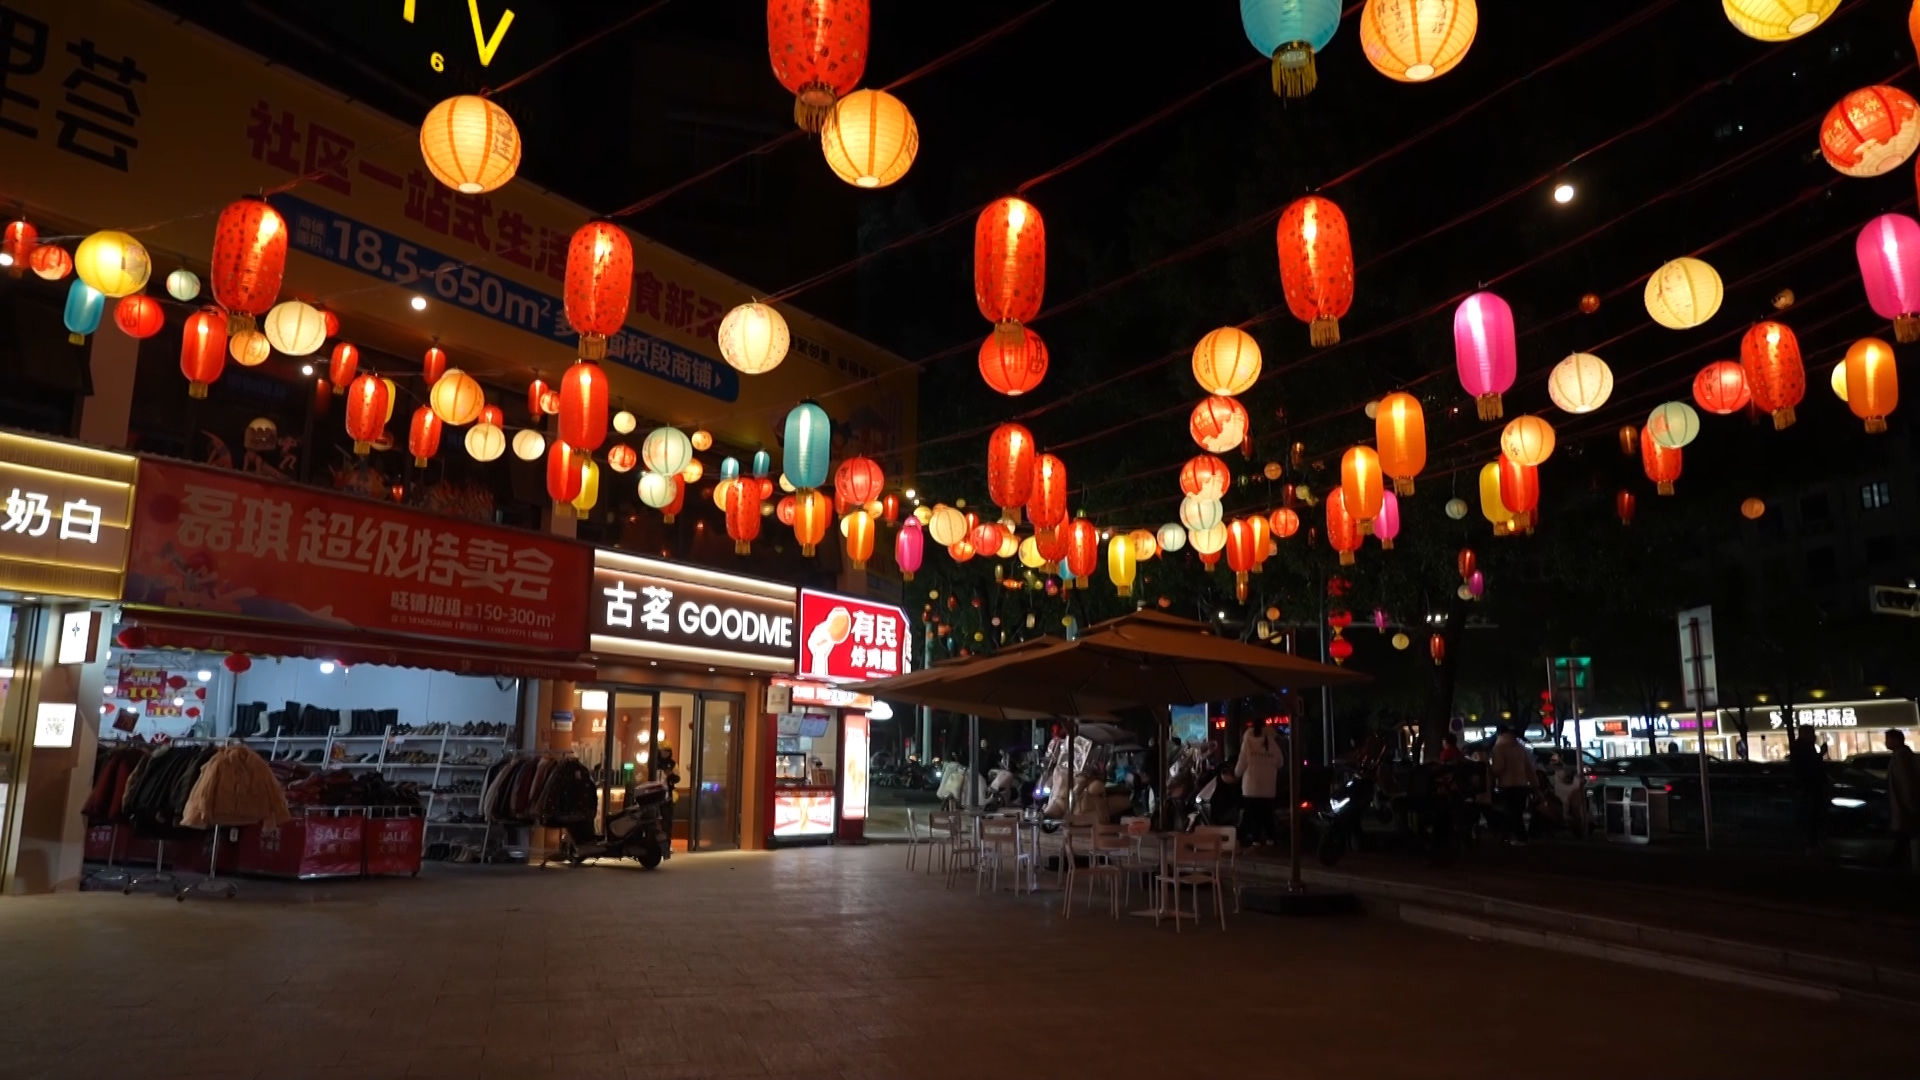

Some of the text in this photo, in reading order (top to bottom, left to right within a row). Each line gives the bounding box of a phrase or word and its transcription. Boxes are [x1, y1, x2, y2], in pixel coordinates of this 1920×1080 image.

[553, 310, 712, 390] 多面积段商铺
[1, 487, 102, 544] 奶白
[603, 580, 794, 649] 古茗 GOODME
[850, 609, 899, 649] 有民
[314, 826, 353, 841] SALE
